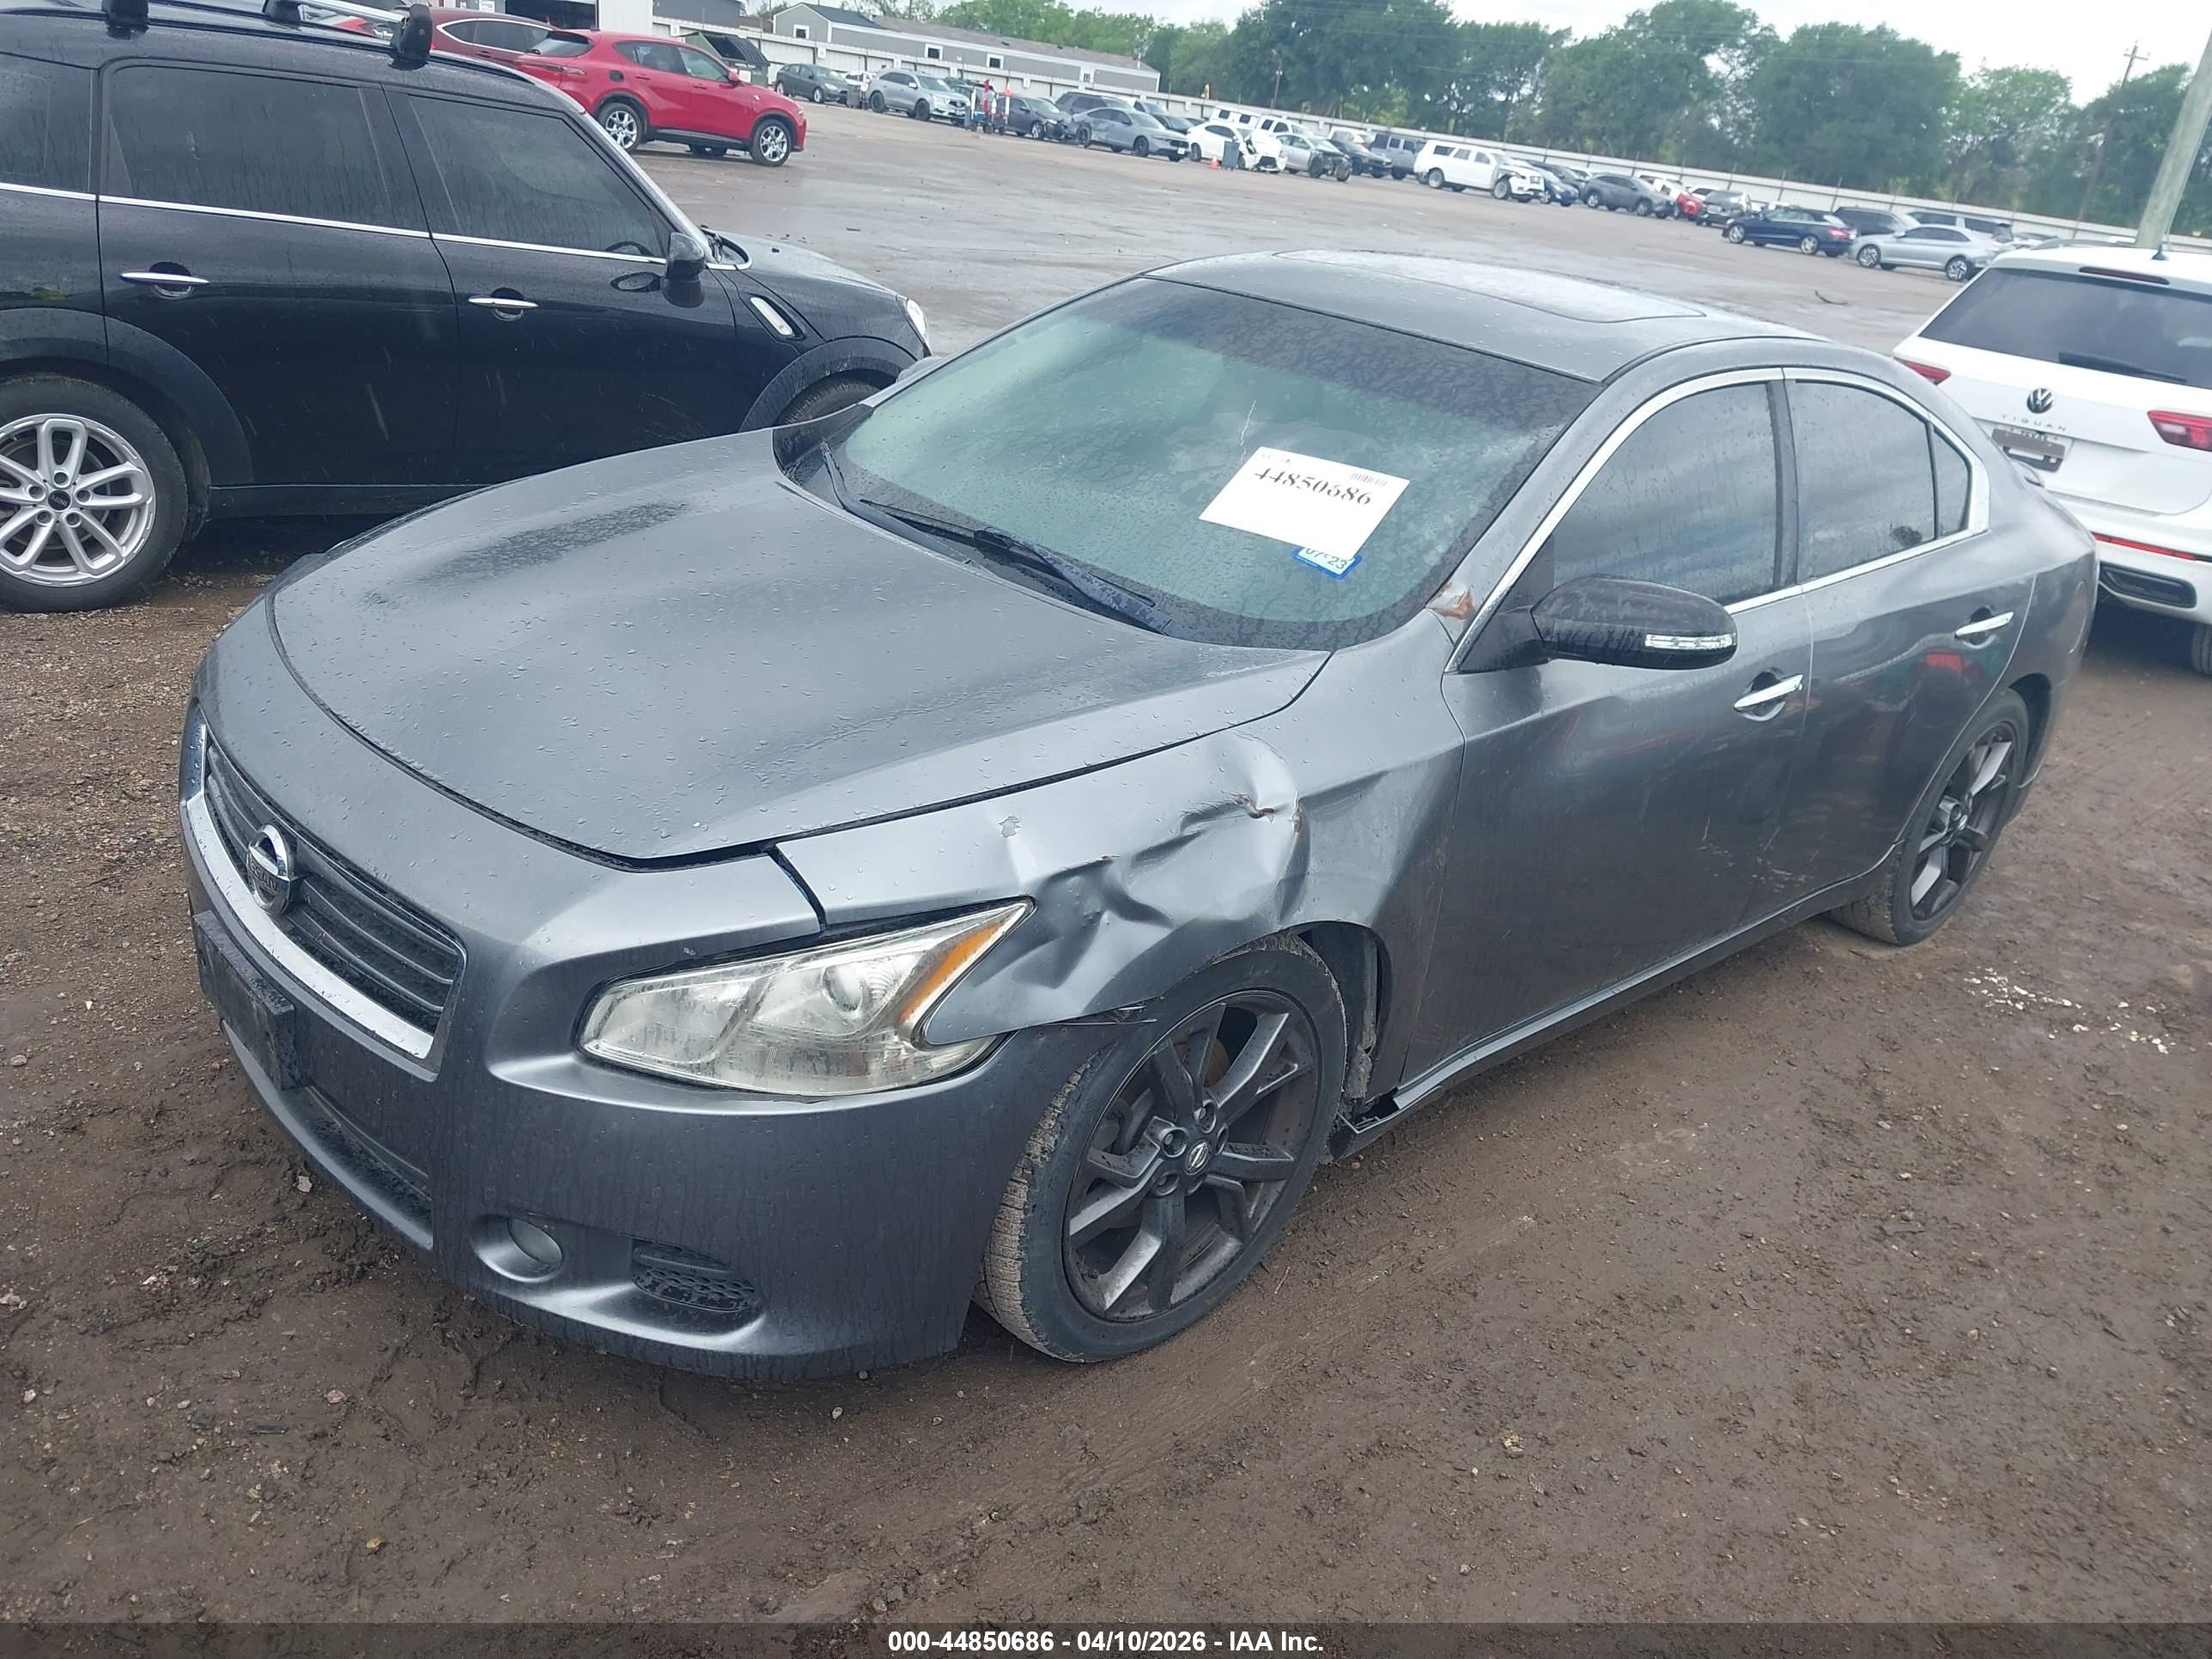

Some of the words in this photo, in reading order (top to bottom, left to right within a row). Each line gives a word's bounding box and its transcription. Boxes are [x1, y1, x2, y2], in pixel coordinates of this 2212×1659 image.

[2002, 414, 2066, 431] TIGUAN
[1254, 467, 1372, 506] 44850686
[1328, 556, 1347, 569] 23
